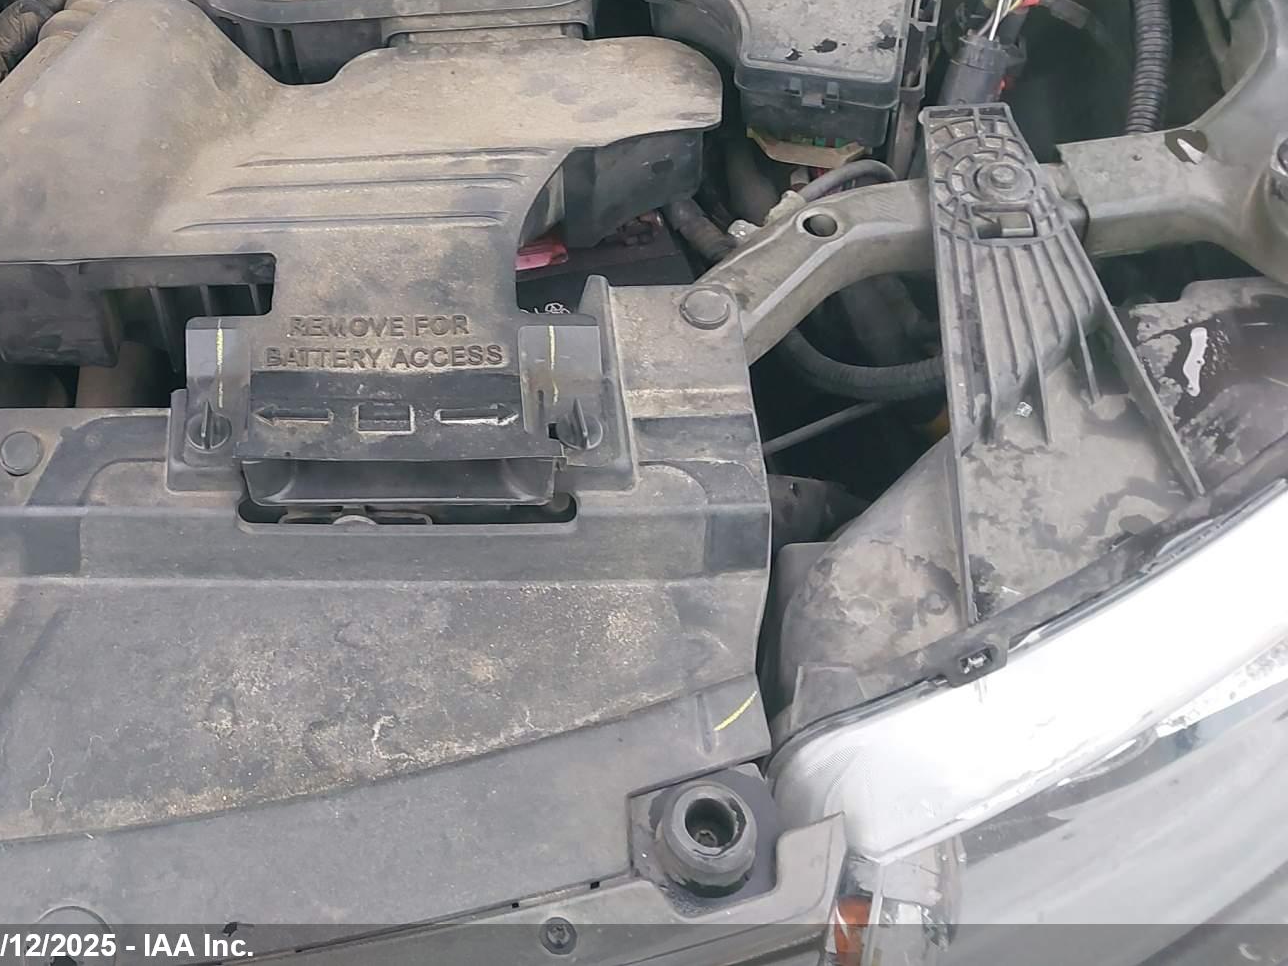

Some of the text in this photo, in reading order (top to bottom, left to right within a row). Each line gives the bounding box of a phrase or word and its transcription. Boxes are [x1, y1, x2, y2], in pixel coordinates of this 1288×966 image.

[289, 313, 469, 337] REMOVE FOR
[266, 343, 504, 369] BATTERY ACCESS
